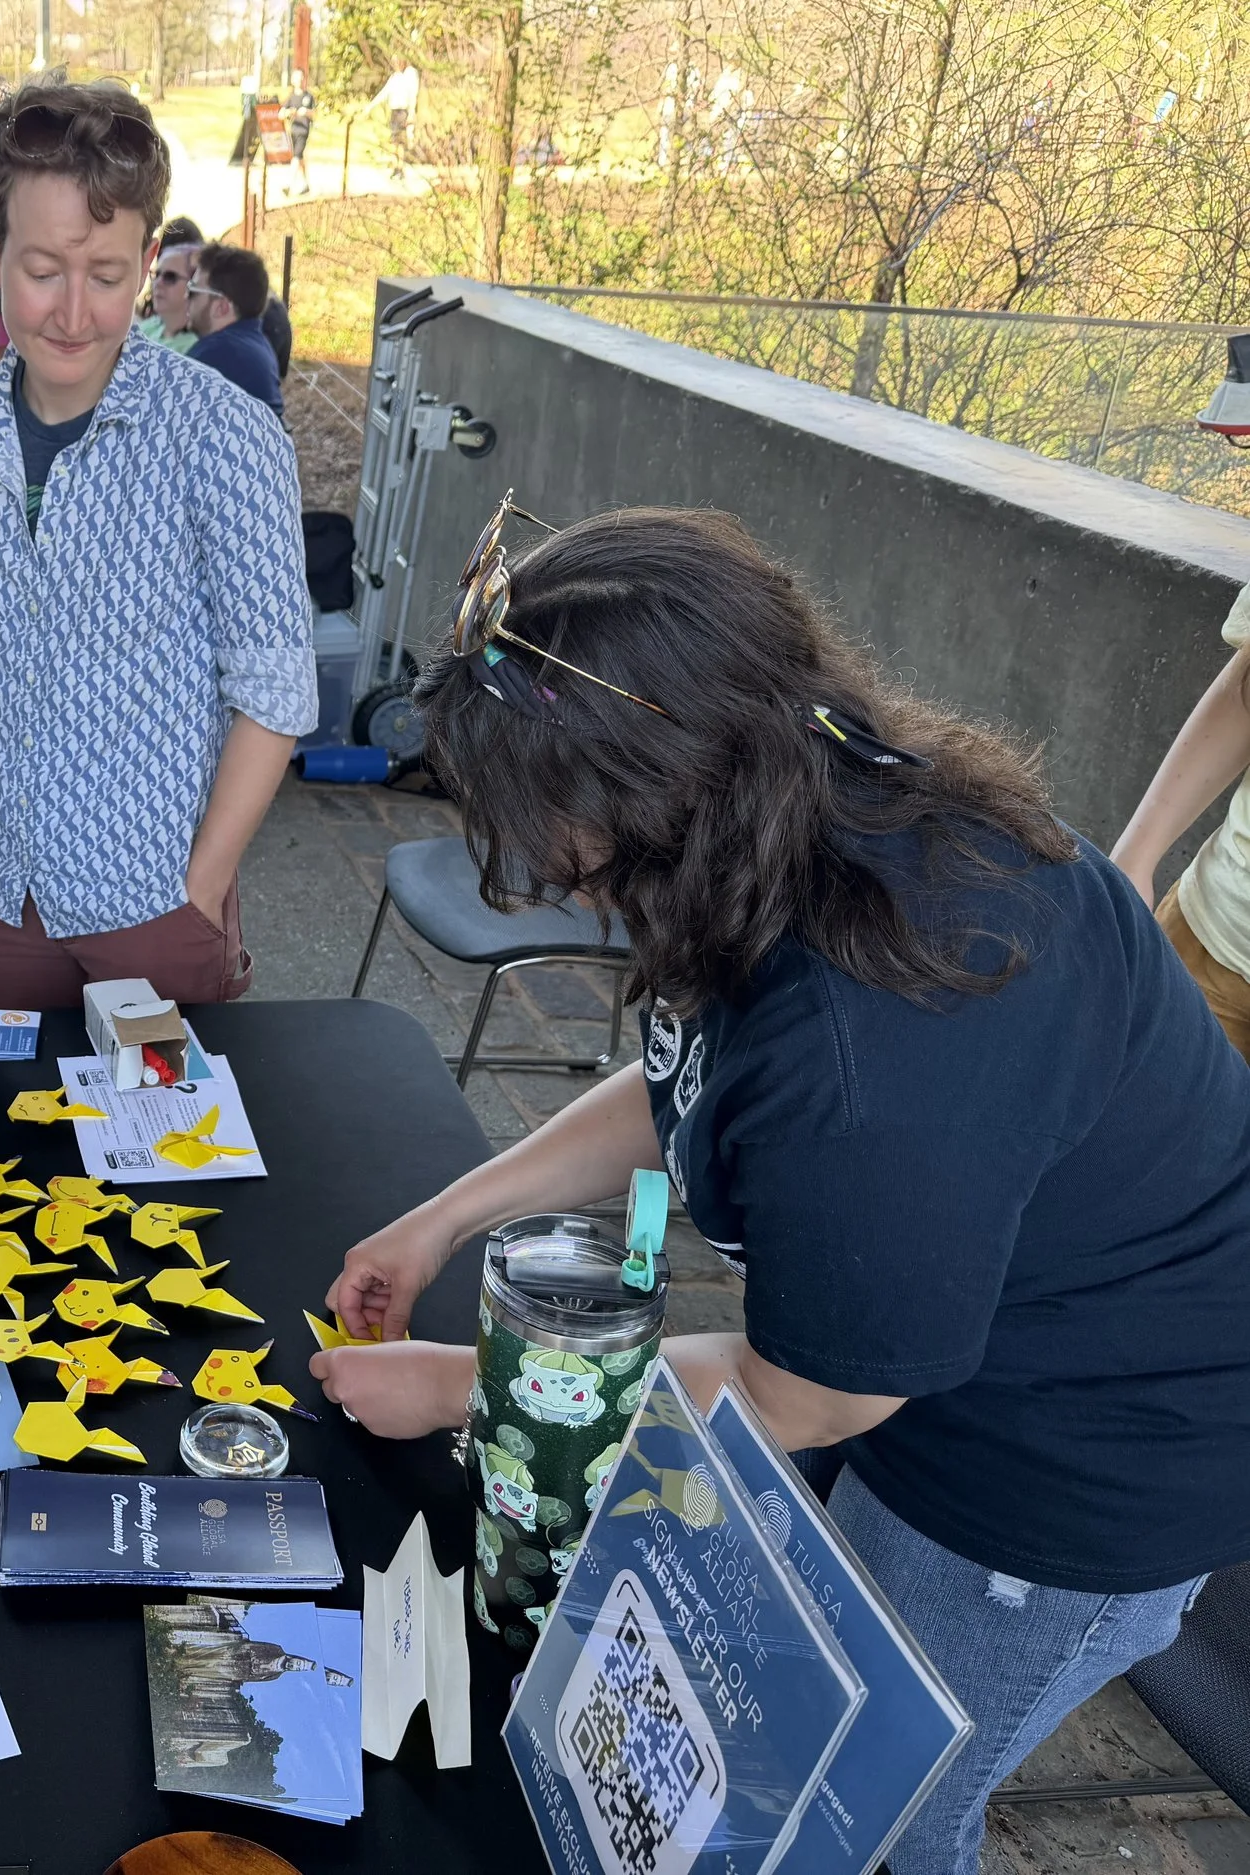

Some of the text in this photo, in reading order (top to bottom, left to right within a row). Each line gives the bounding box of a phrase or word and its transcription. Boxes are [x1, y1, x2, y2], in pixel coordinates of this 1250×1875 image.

[108, 1493, 129, 1555] Community
[134, 1482, 160, 1568] Building Global
[200, 1518, 211, 1556] ALLIANCE
[208, 1519, 218, 1549] GLOBAL
[217, 1520, 226, 1544] TULSA
[265, 1491, 293, 1566] PASSPORT
[719, 1512, 759, 1594] TULSA
[644, 1499, 678, 1552] SIGN
[676, 1557, 698, 1596] UP
[695, 1597, 728, 1663] FOR
[728, 1663, 763, 1732] OUR
[700, 1548, 768, 1671] ALLIANCE
[709, 1531, 760, 1631] GLOBAL
[793, 1539, 842, 1623] TULSA
[648, 1544, 738, 1730] NEWSLETTER
[529, 1727, 562, 1808] RECEIVE
[820, 1780, 854, 1828] gaged!
[818, 1800, 854, 1857] exchanges
